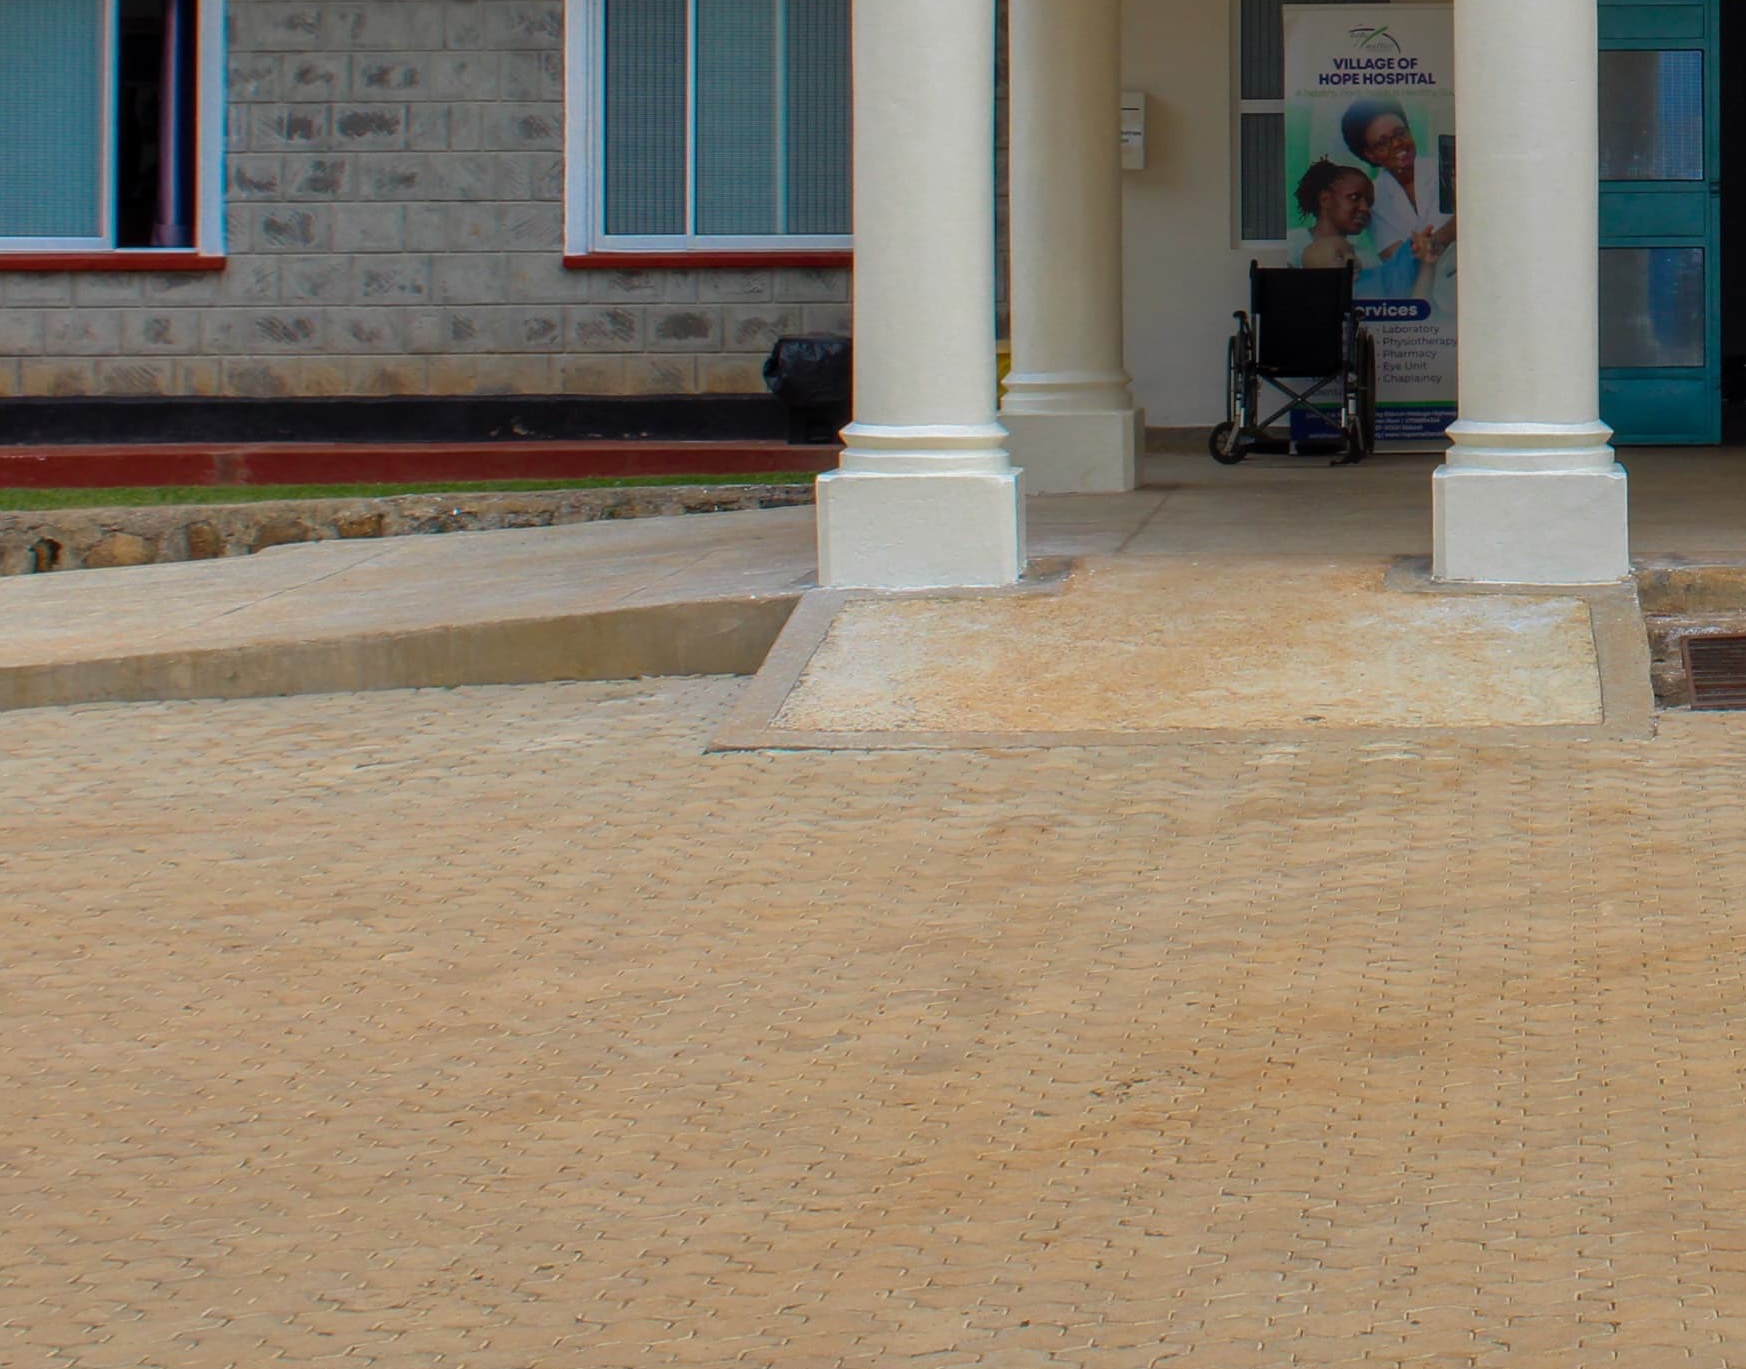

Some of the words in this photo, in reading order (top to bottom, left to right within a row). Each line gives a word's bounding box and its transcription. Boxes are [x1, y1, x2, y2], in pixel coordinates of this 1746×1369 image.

[1332, 58, 1396, 70] VILLAGE
[1397, 57, 1418, 70] OF
[1319, 73, 1360, 85] HOPE
[1362, 72, 1436, 85] HOSPITAL
[1382, 325, 1440, 335] Laboratory
[1382, 337, 1457, 348] Physiotherapy
[1382, 349, 1437, 360] Pharmacy
[1382, 362, 1402, 372] Eye
[1405, 361, 1427, 371] Unit
[1382, 374, 1442, 384] Chaplaincy
